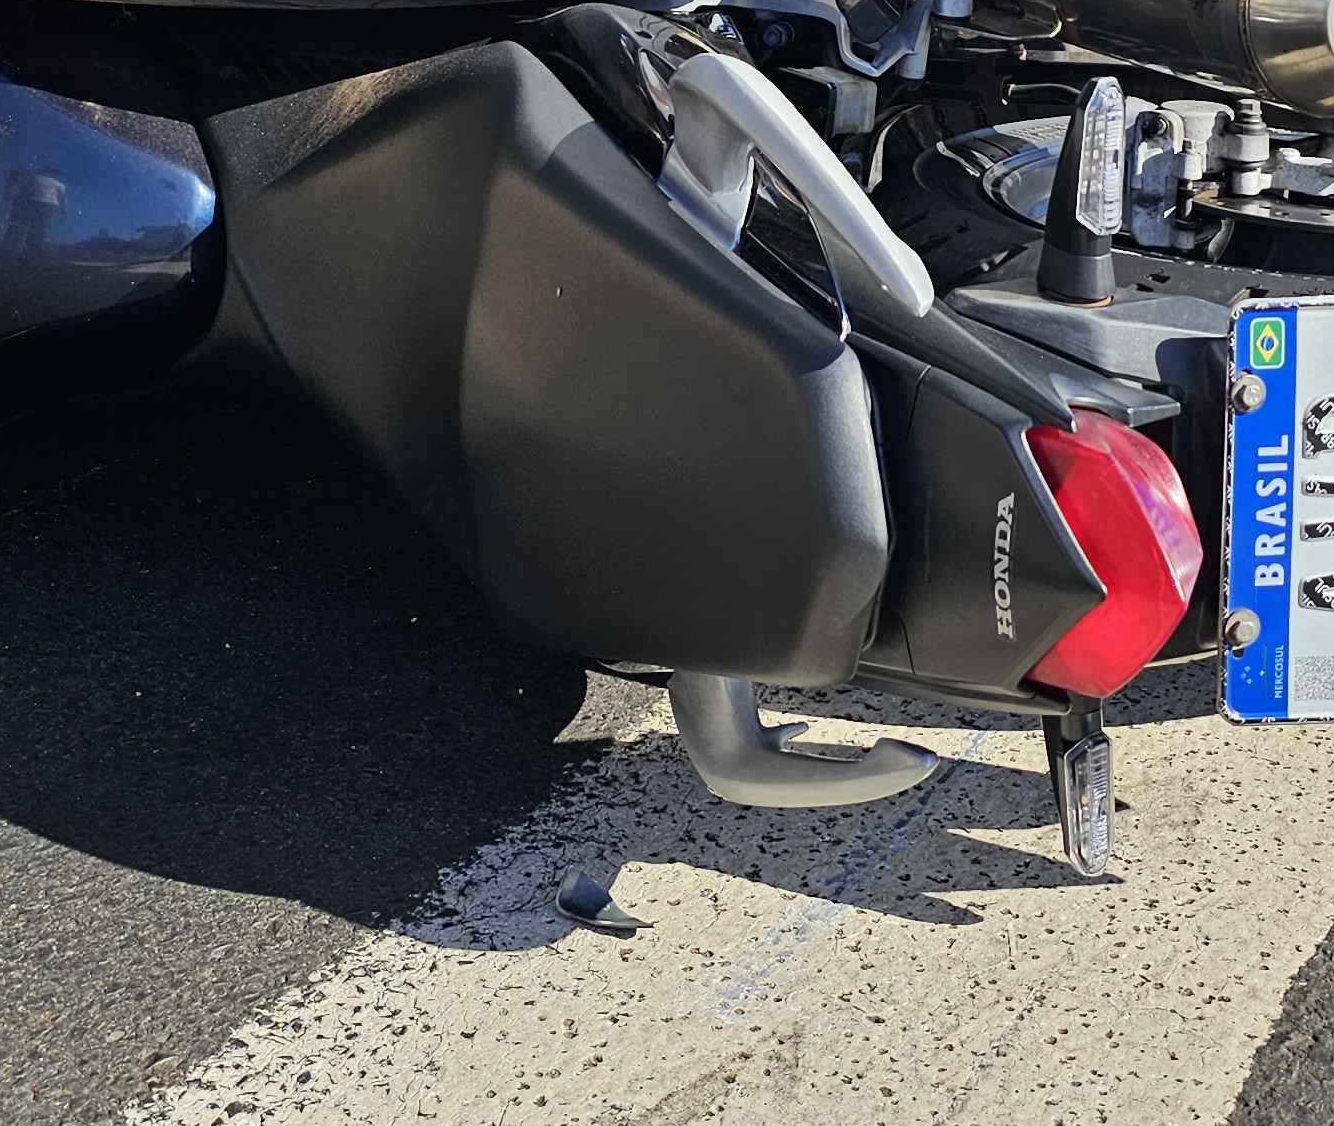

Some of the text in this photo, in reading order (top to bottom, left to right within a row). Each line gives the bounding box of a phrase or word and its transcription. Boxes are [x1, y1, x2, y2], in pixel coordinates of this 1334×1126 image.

[994, 493, 1015, 641] HONDA
[1254, 433, 1290, 587] BRASIL
[1273, 644, 1285, 699] MERCOSUL
